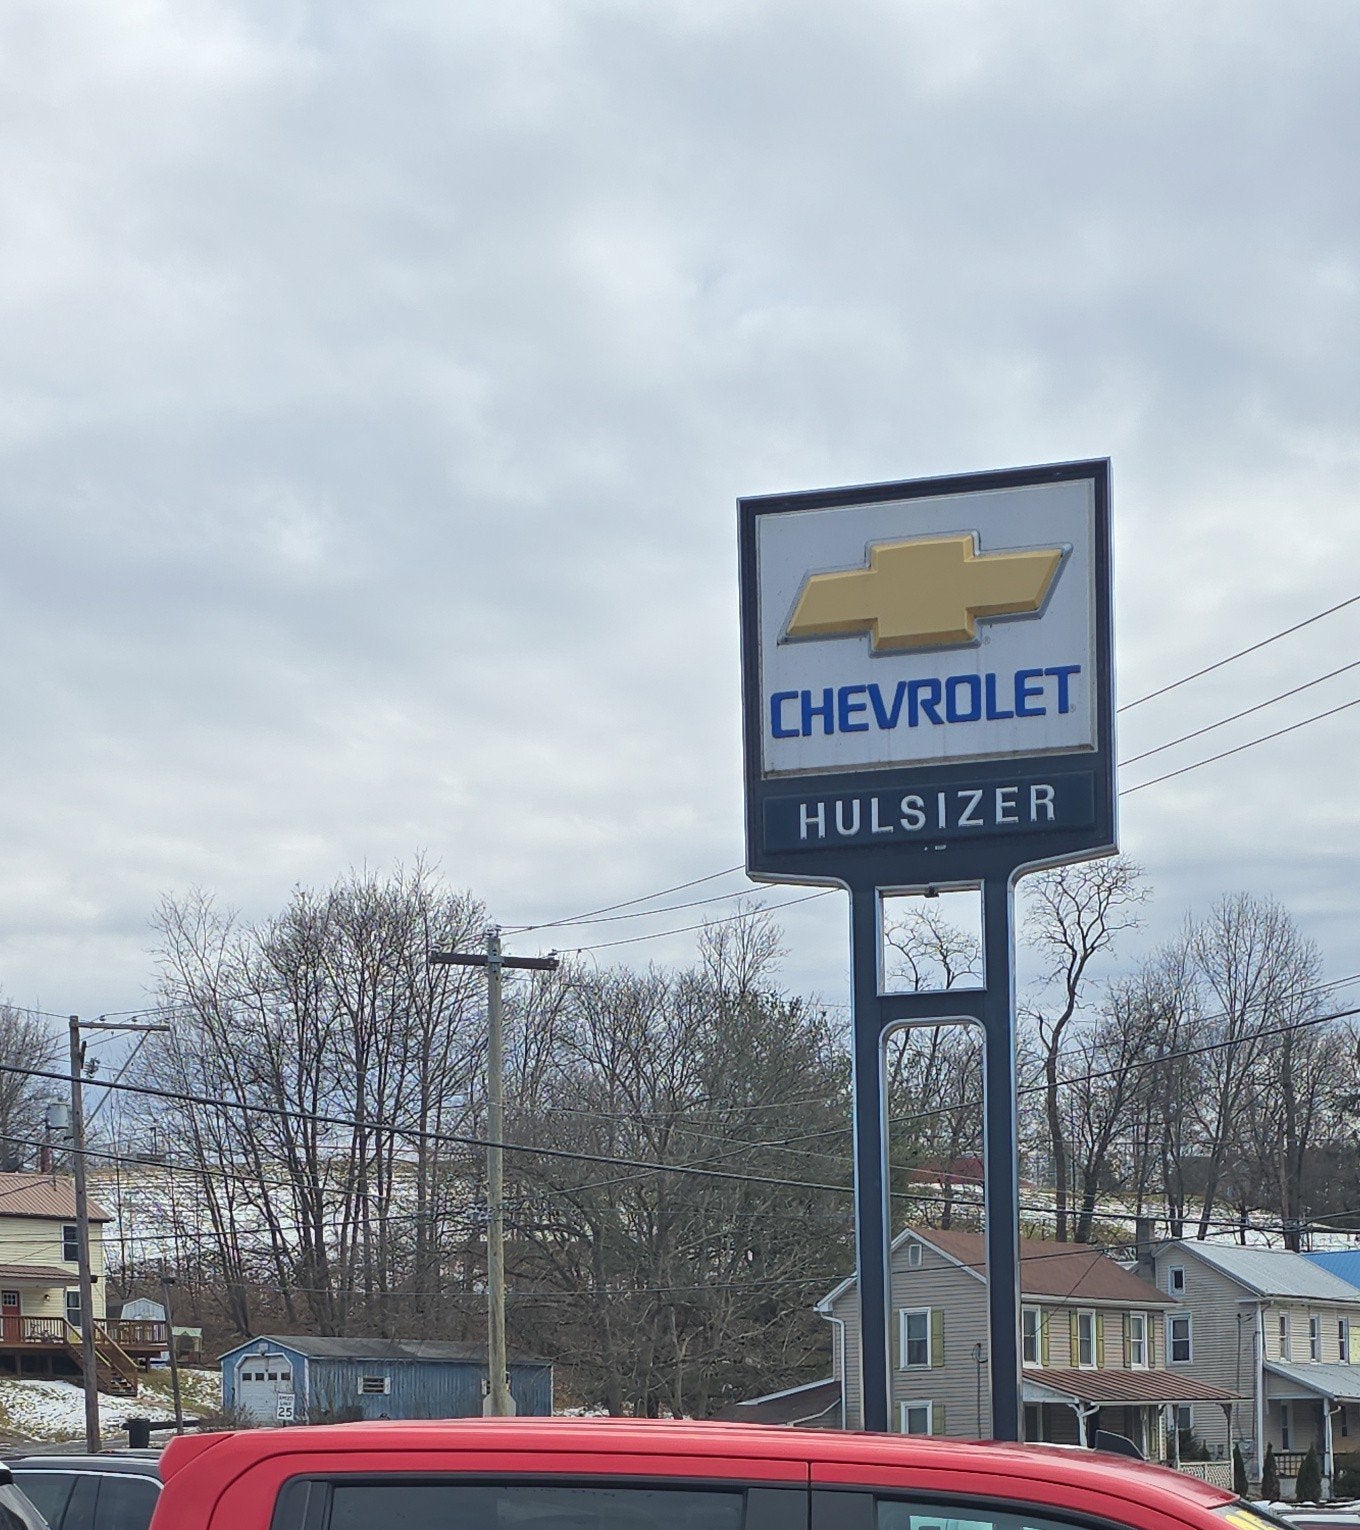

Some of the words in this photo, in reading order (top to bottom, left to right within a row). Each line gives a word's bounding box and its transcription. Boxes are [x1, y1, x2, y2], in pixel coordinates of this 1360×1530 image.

[770, 664, 1082, 739] CHEVROLET
[798, 784, 1057, 840] HULSIZER
[278, 1407, 293, 1418] 25
